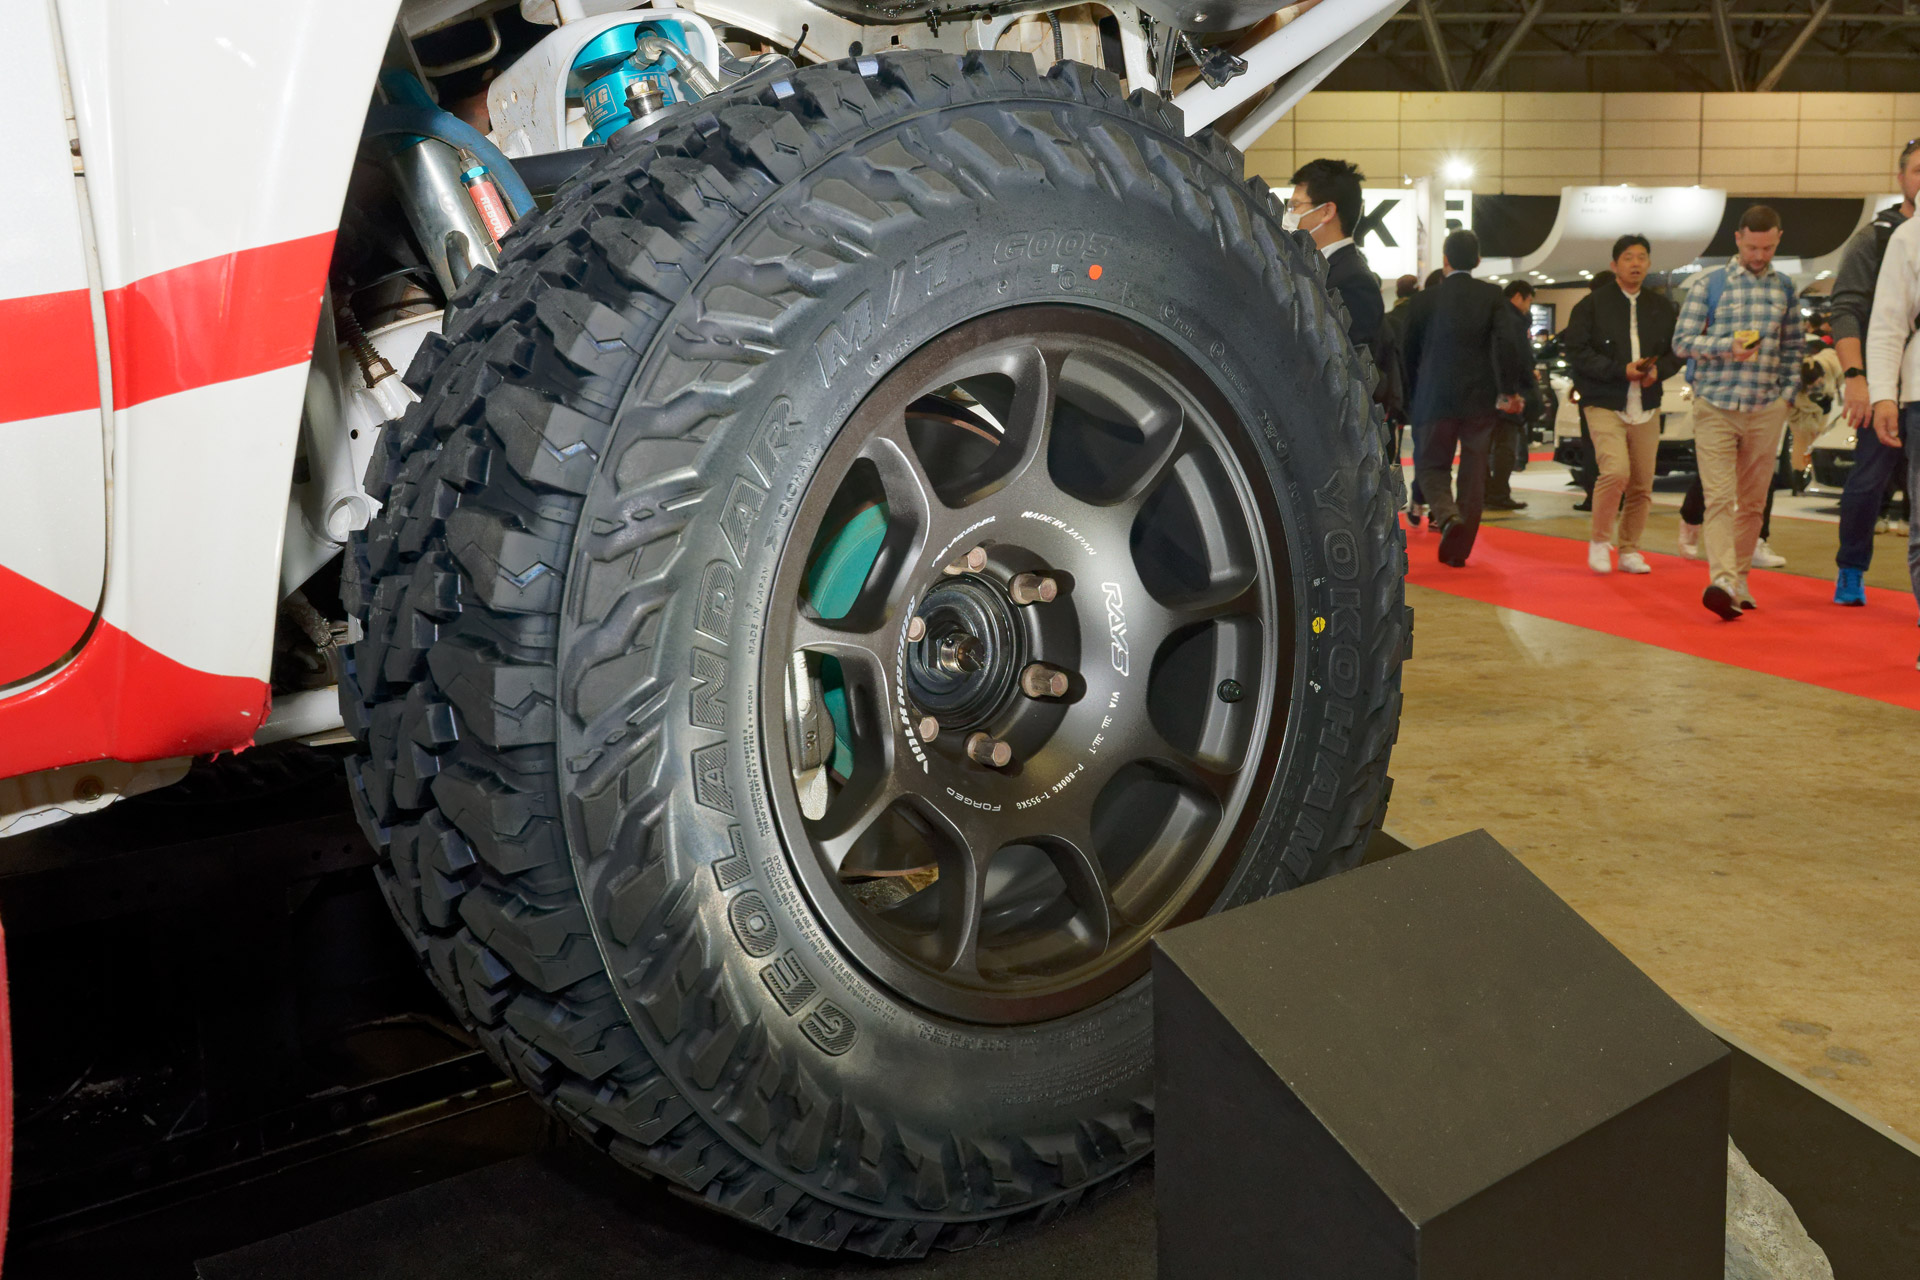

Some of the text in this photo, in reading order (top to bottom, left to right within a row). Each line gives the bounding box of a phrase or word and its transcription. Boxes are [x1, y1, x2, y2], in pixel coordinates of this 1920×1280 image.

[1583, 192, 1609, 204] Tune
[1631, 193, 1654, 205] Next
[1020, 510, 1097, 555] MADE IN JAPAN
[748, 566, 769, 654] MADE IN JAPAN
[1101, 582, 1129, 677] RAYS
[689, 394, 860, 1057] GEOLANDAR
[814, 229, 968, 388] M/T
[1108, 692, 1120, 708] VIA
[1051, 762, 1084, 793] P-800KG
[945, 786, 1001, 811] FORGED
[1015, 791, 1050, 810] T-955KG
[765, 856, 777, 877] COLD
[772, 854, 784, 875] COLD
[771, 889, 783, 906] LOAD
[853, 980, 870, 995] DUAL
